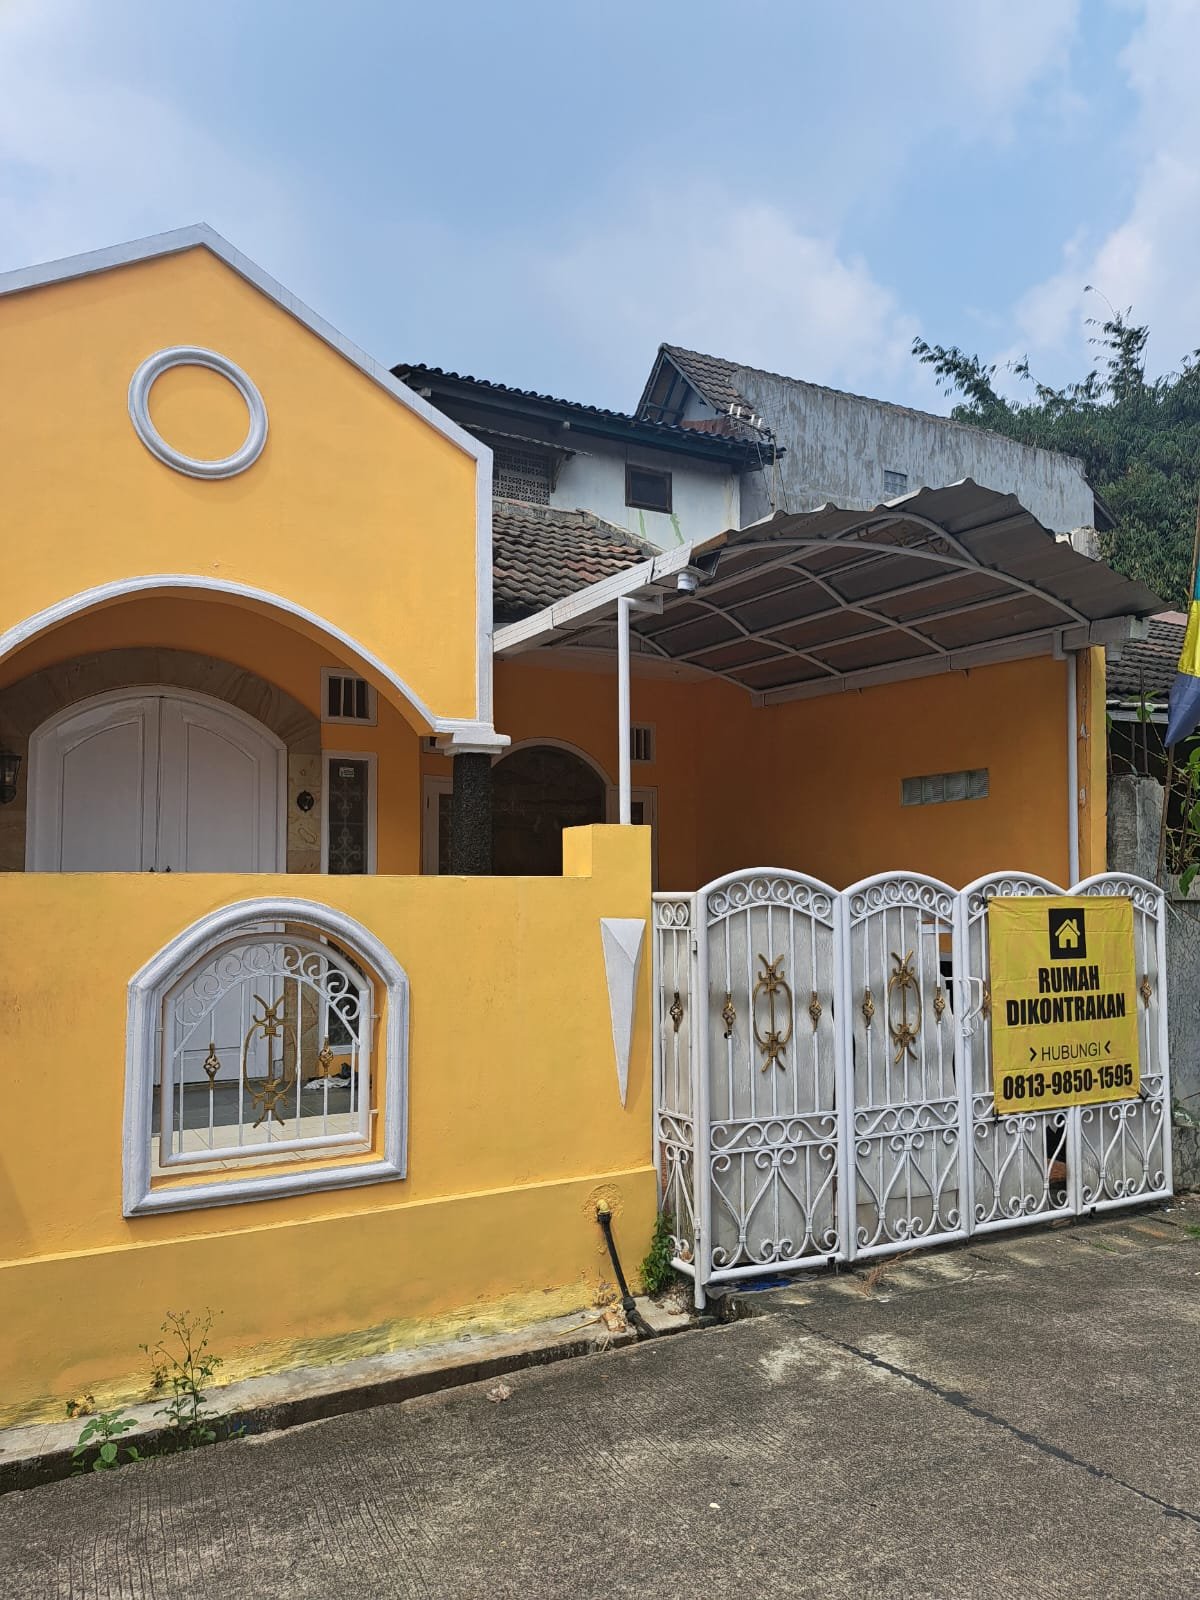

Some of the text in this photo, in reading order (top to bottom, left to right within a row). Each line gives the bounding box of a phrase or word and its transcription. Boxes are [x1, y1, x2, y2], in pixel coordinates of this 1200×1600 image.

[1038, 965, 1100, 993] RUMAH
[1006, 993, 1126, 1026] DIKONTRAKAN
[1041, 1042, 1101, 1061] HUBUNGI
[1003, 1064, 1133, 1100] 0813-9850-1595
